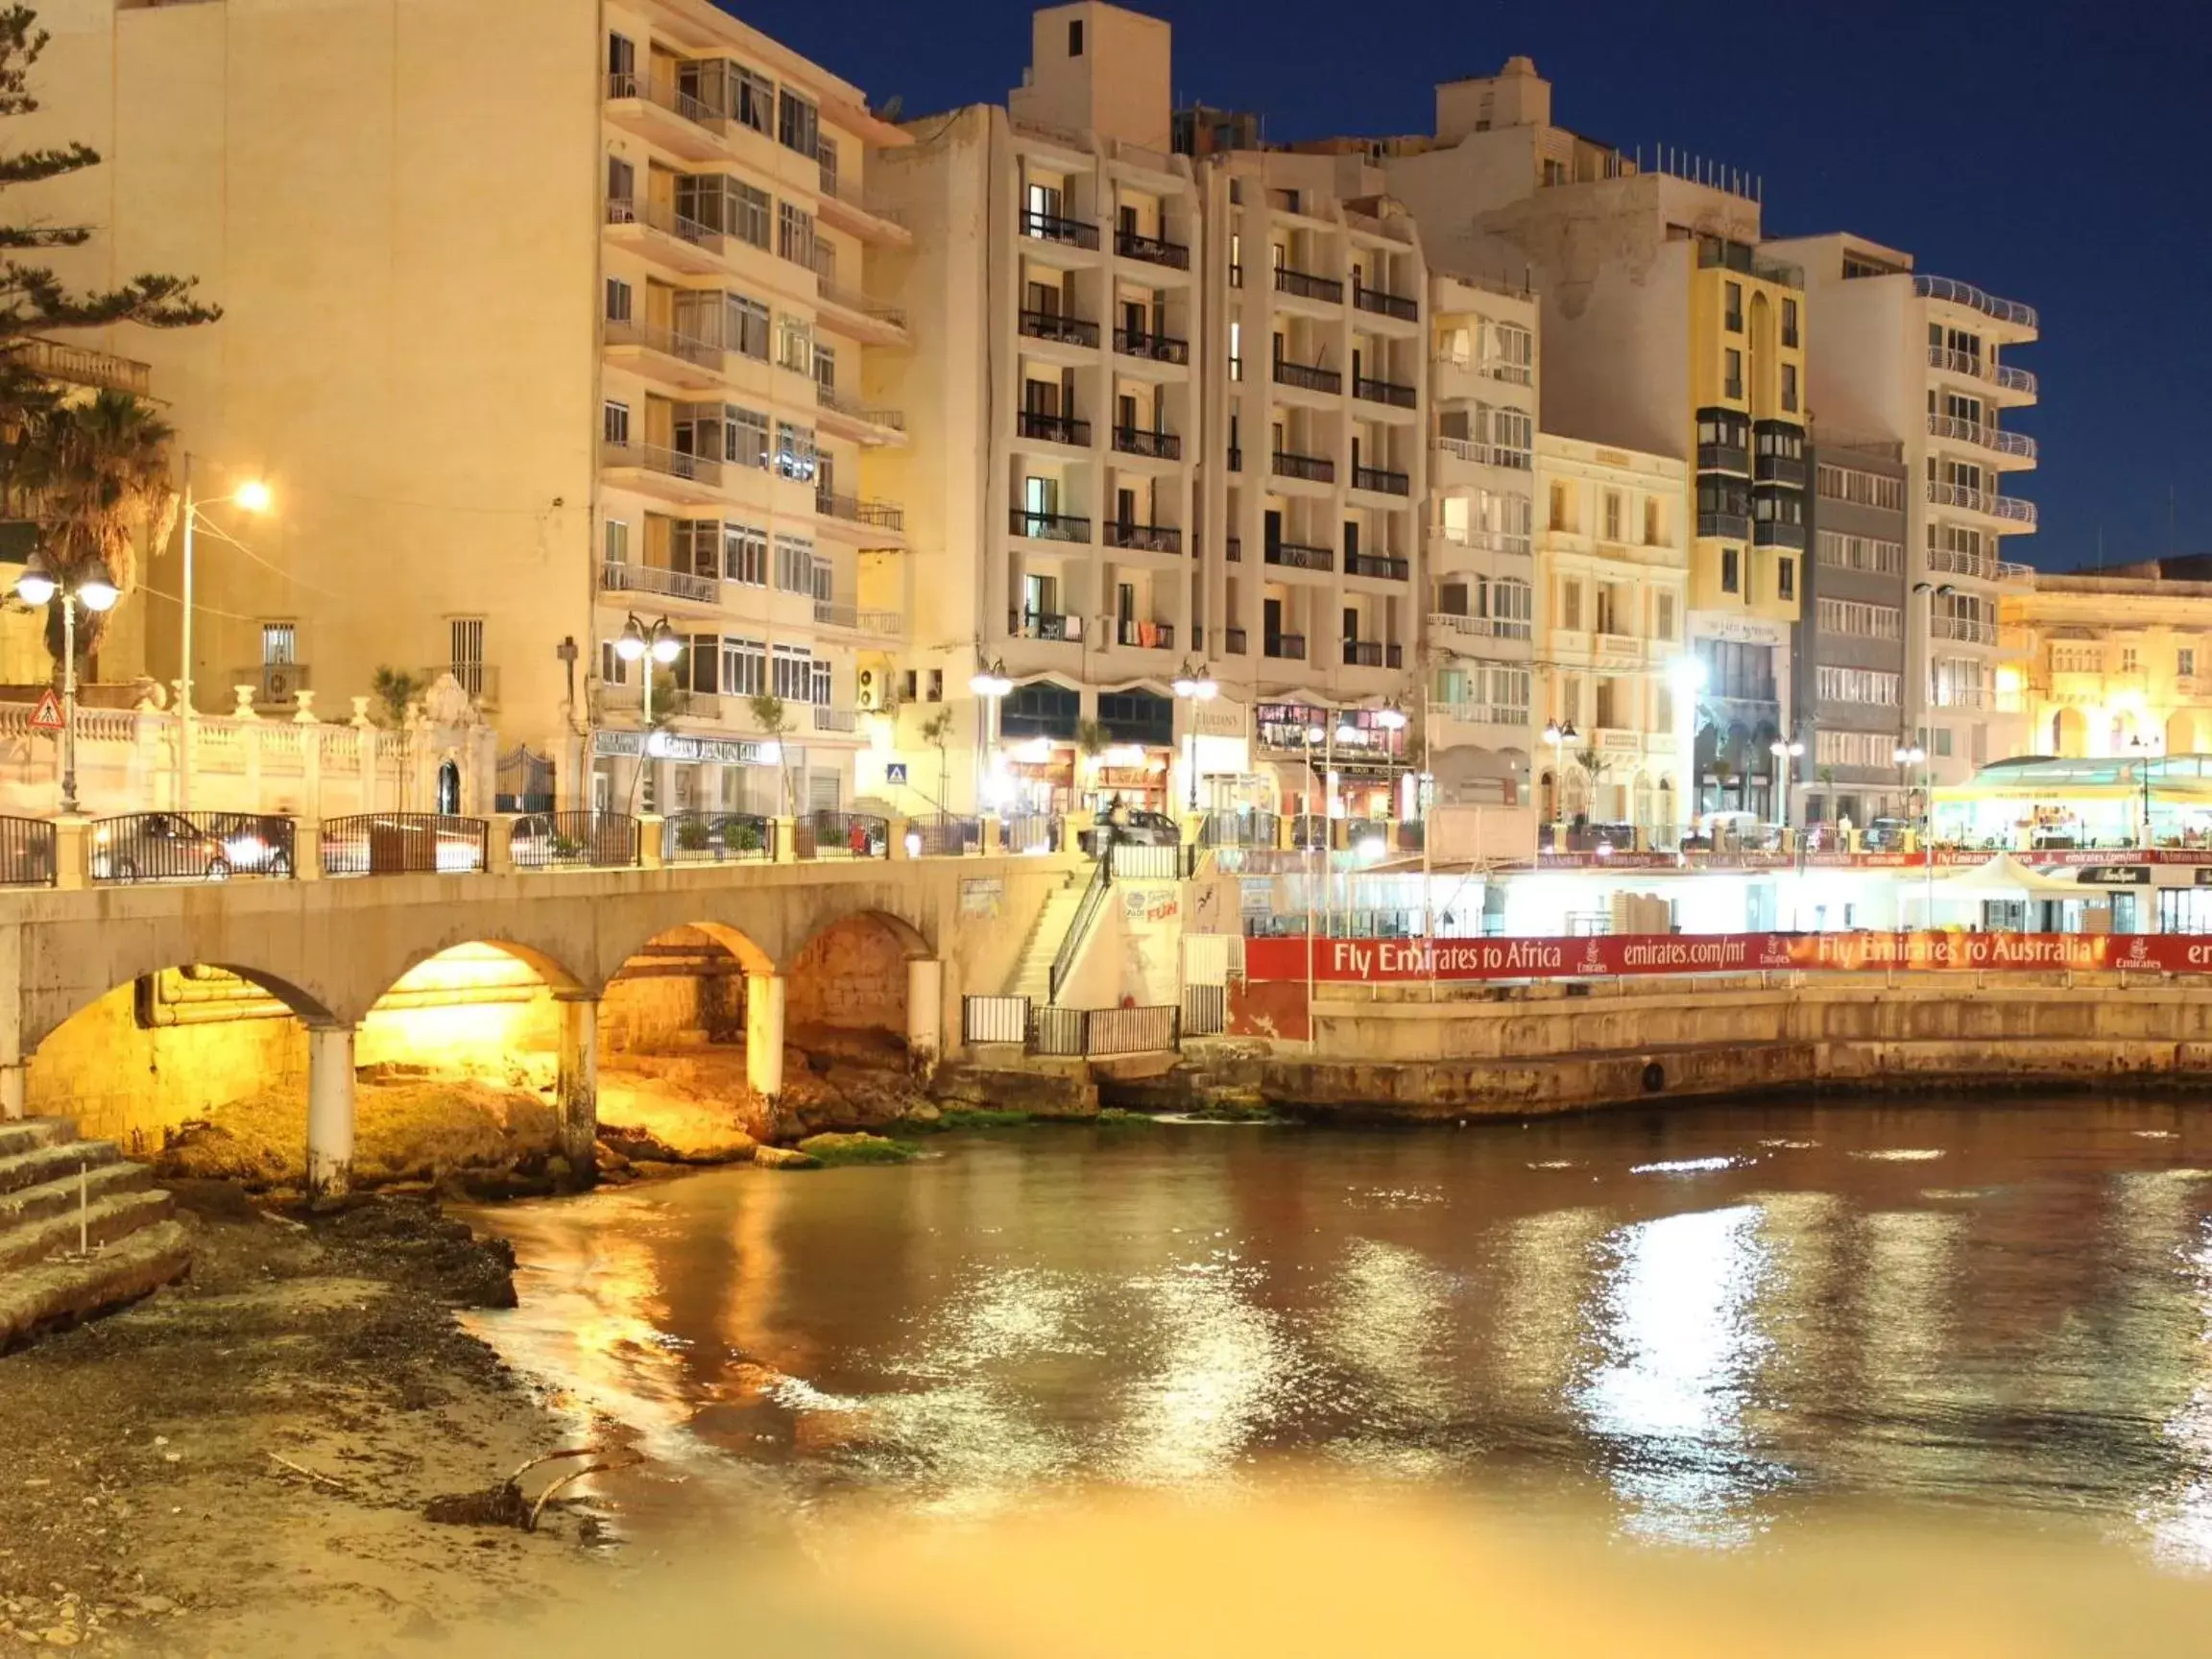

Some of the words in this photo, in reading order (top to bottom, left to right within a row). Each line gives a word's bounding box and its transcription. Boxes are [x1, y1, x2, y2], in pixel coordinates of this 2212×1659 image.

[1147, 901, 1177, 924] FUN
[1334, 943, 1372, 979] Fly
[1379, 940, 1478, 973] Emirates
[1483, 944, 1503, 969] to
[1506, 941, 1562, 969] Africa
[1623, 935, 1746, 969] emirates.com/mt
[1819, 937, 1853, 971] Fly
[1861, 937, 1958, 961] Emirates
[1964, 939, 1985, 961] to
[1992, 937, 2092, 962] Australia
[2115, 957, 2161, 969] Emirates
[1577, 961, 1607, 974] Emirates
